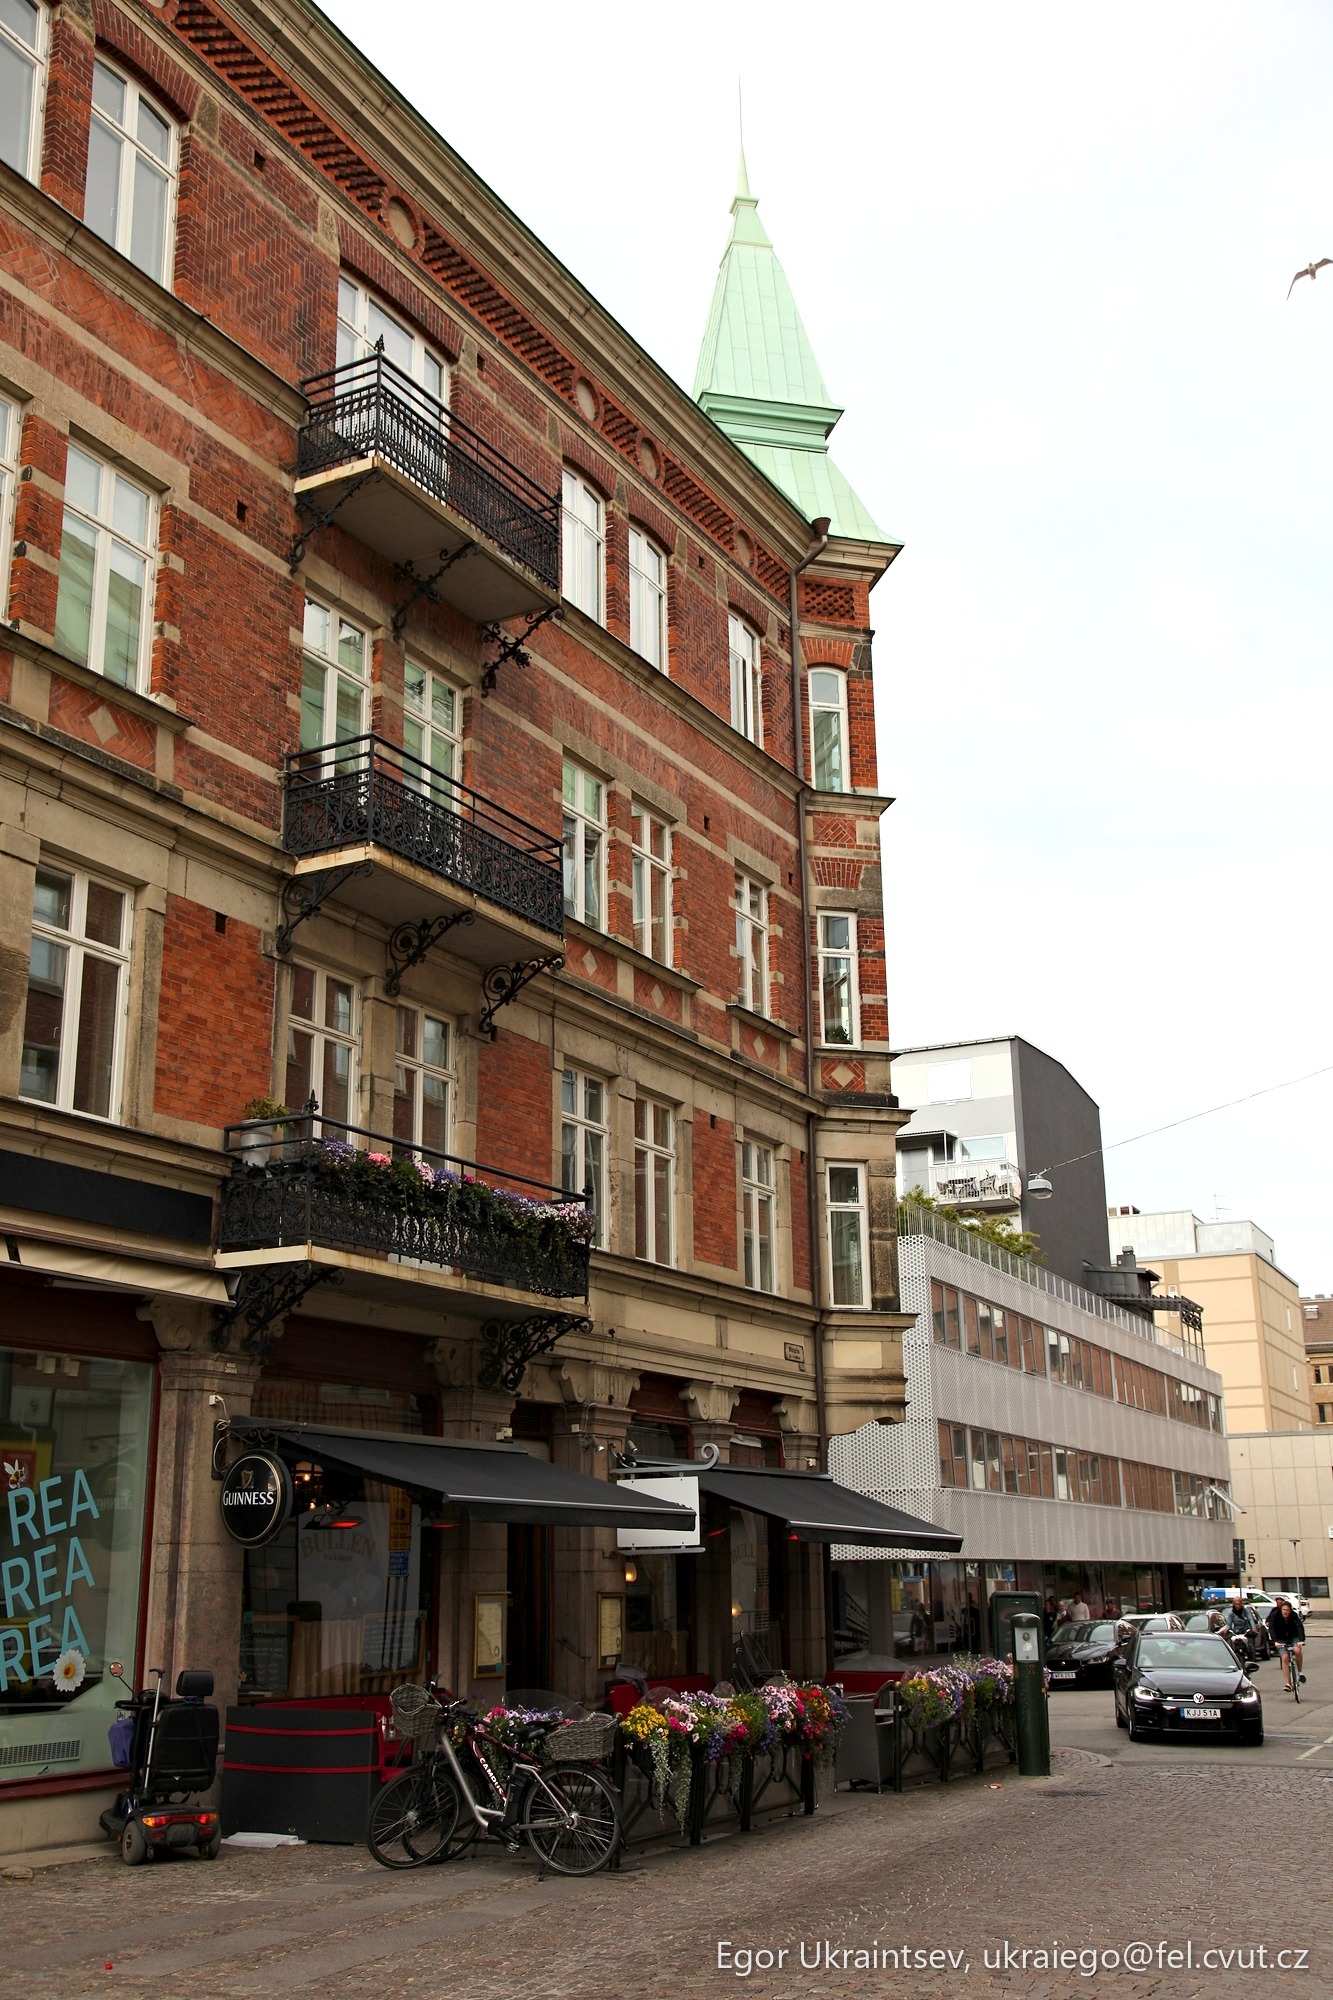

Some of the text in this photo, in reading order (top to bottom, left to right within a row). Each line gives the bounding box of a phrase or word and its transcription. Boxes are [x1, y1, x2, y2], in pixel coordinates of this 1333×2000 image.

[7, 1468, 100, 1547] REA
[223, 1490, 275, 1506] GUINNESS
[300, 1530, 376, 1560] BULLEN
[1248, 1553, 1256, 1564] 5
[2, 1536, 96, 1618] REA
[0, 1605, 90, 1692] REA
